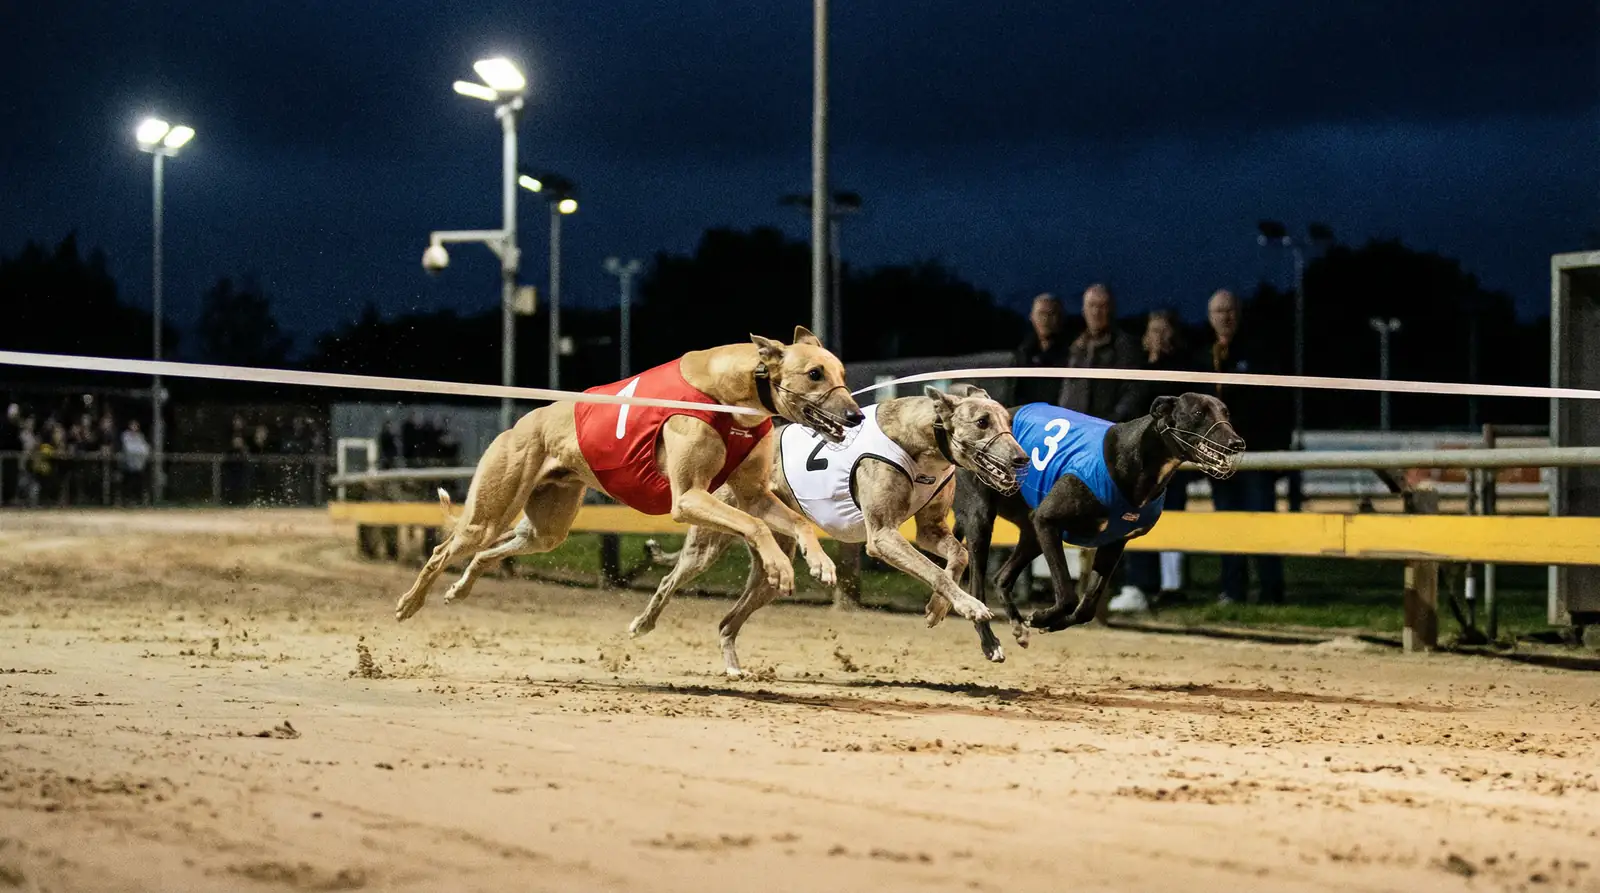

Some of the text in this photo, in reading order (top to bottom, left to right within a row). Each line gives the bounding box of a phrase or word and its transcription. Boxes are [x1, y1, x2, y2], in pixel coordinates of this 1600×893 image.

[615, 376, 641, 440] 1
[806, 431, 829, 472] 2
[1031, 418, 1071, 472] 3
